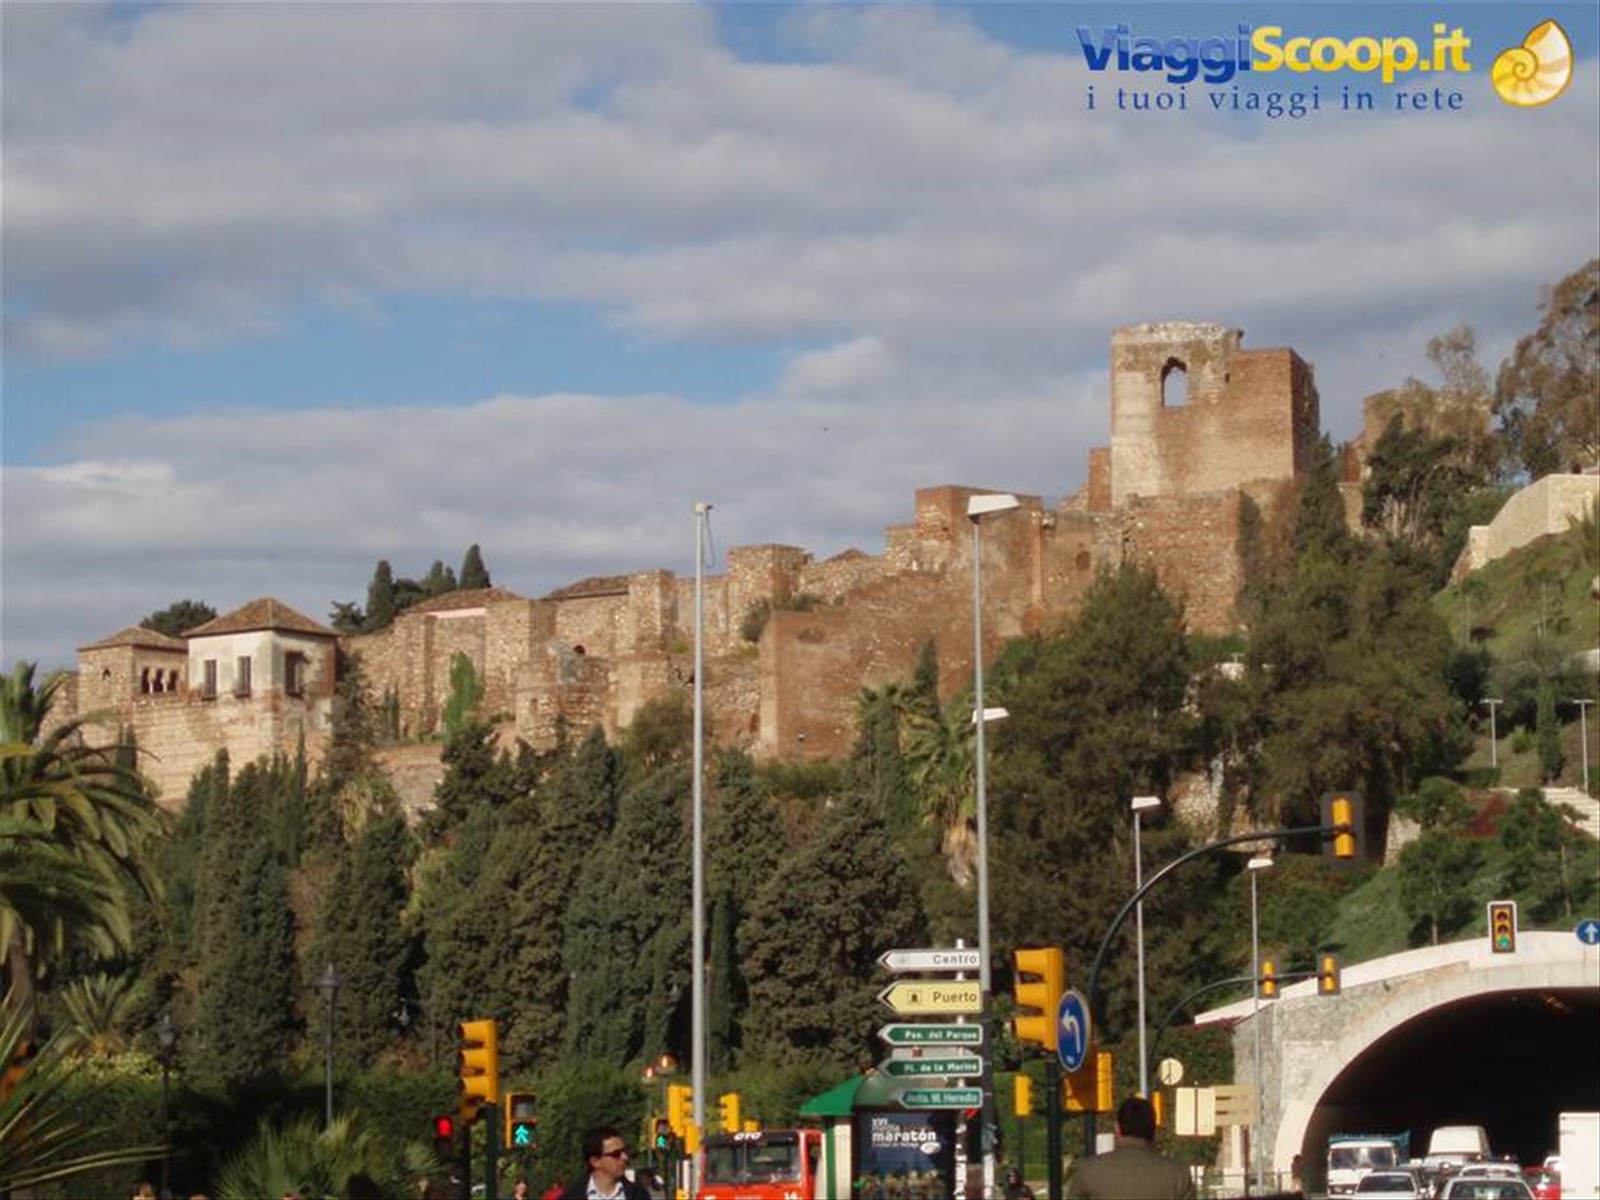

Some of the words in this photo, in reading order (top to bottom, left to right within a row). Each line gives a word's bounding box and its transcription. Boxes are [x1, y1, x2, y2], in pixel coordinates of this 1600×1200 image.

[932, 954, 977, 965] Centro
[932, 991, 977, 1003] Puerto
[946, 1030, 977, 1041] Parque
[920, 1063, 932, 1072] de
[934, 1062, 944, 1071] la
[947, 1061, 977, 1071] Marina
[872, 1128, 936, 1142] maratón
